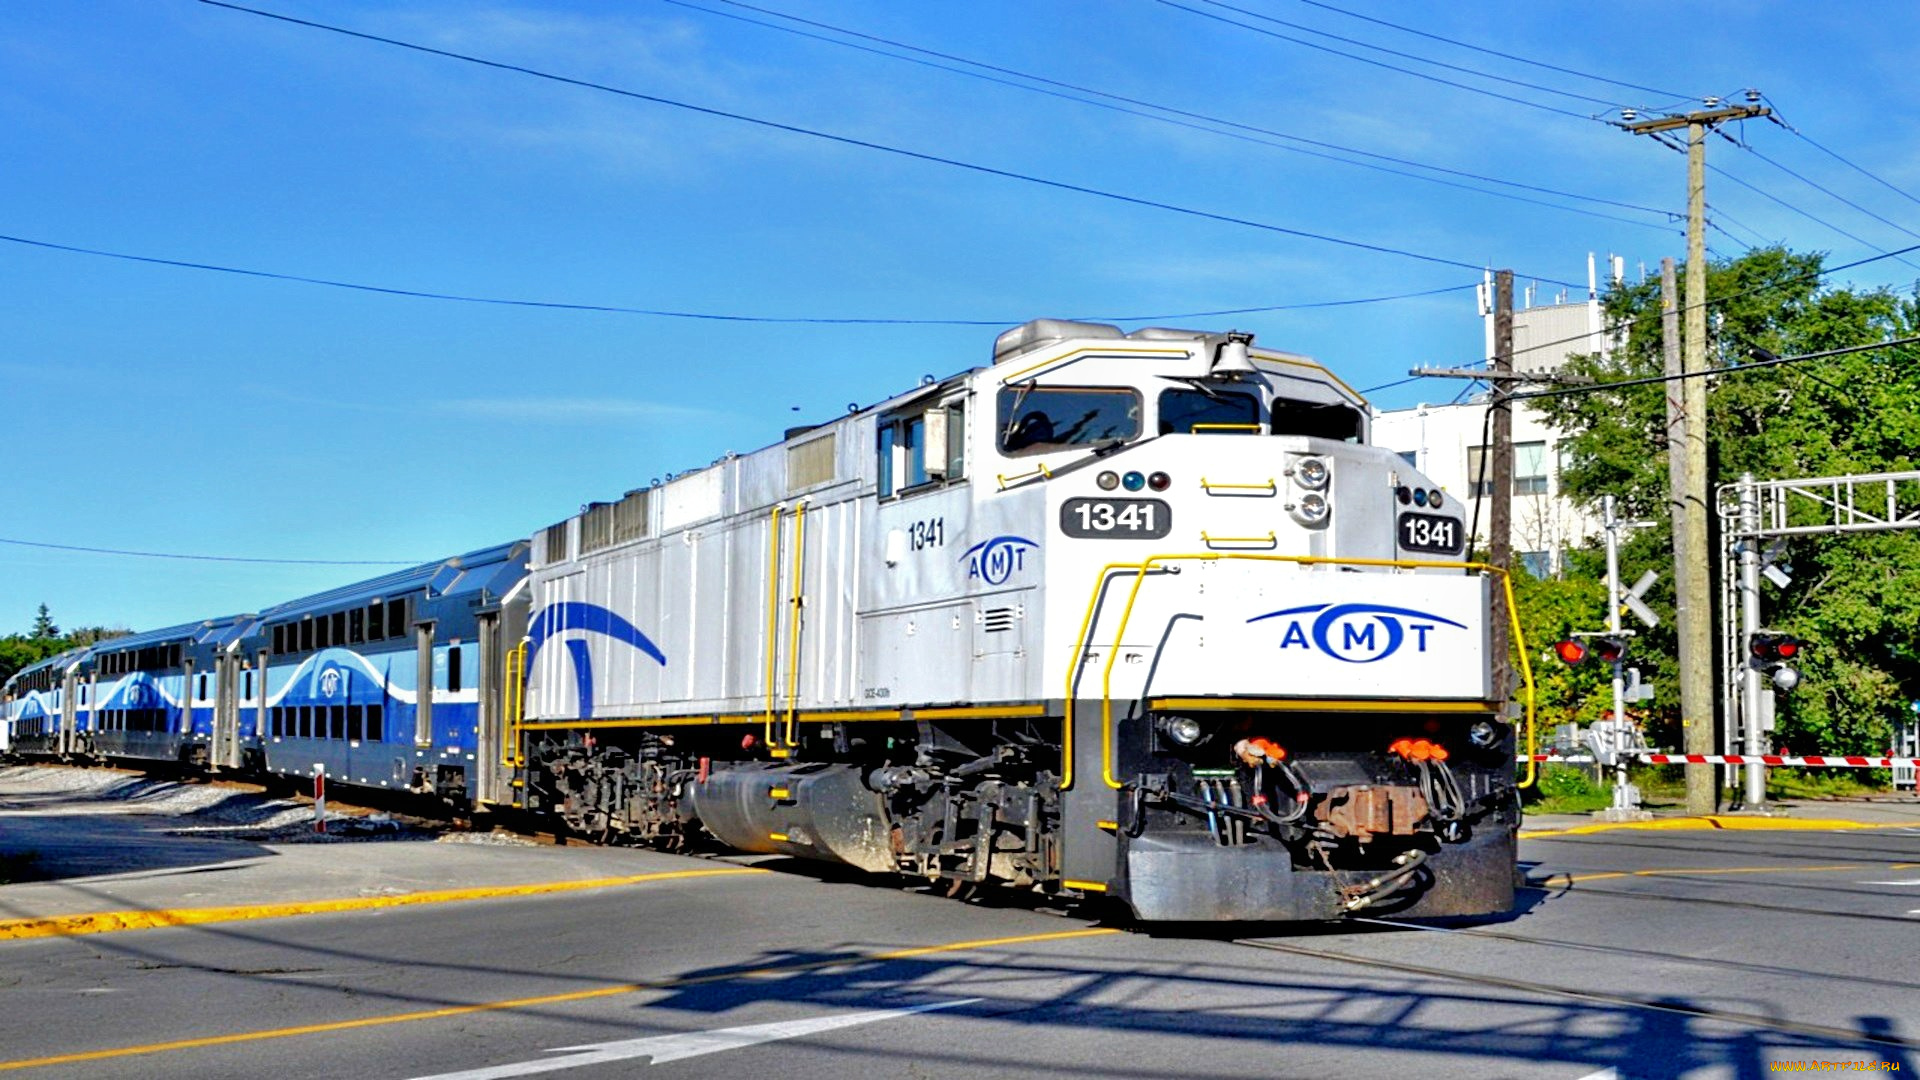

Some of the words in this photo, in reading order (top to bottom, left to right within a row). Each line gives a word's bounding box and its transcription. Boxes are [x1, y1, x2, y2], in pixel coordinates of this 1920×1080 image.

[1075, 503, 1155, 531] 1341
[908, 517, 944, 551] 1341
[1405, 519, 1454, 547] 1341
[969, 546, 1026, 580] AMT
